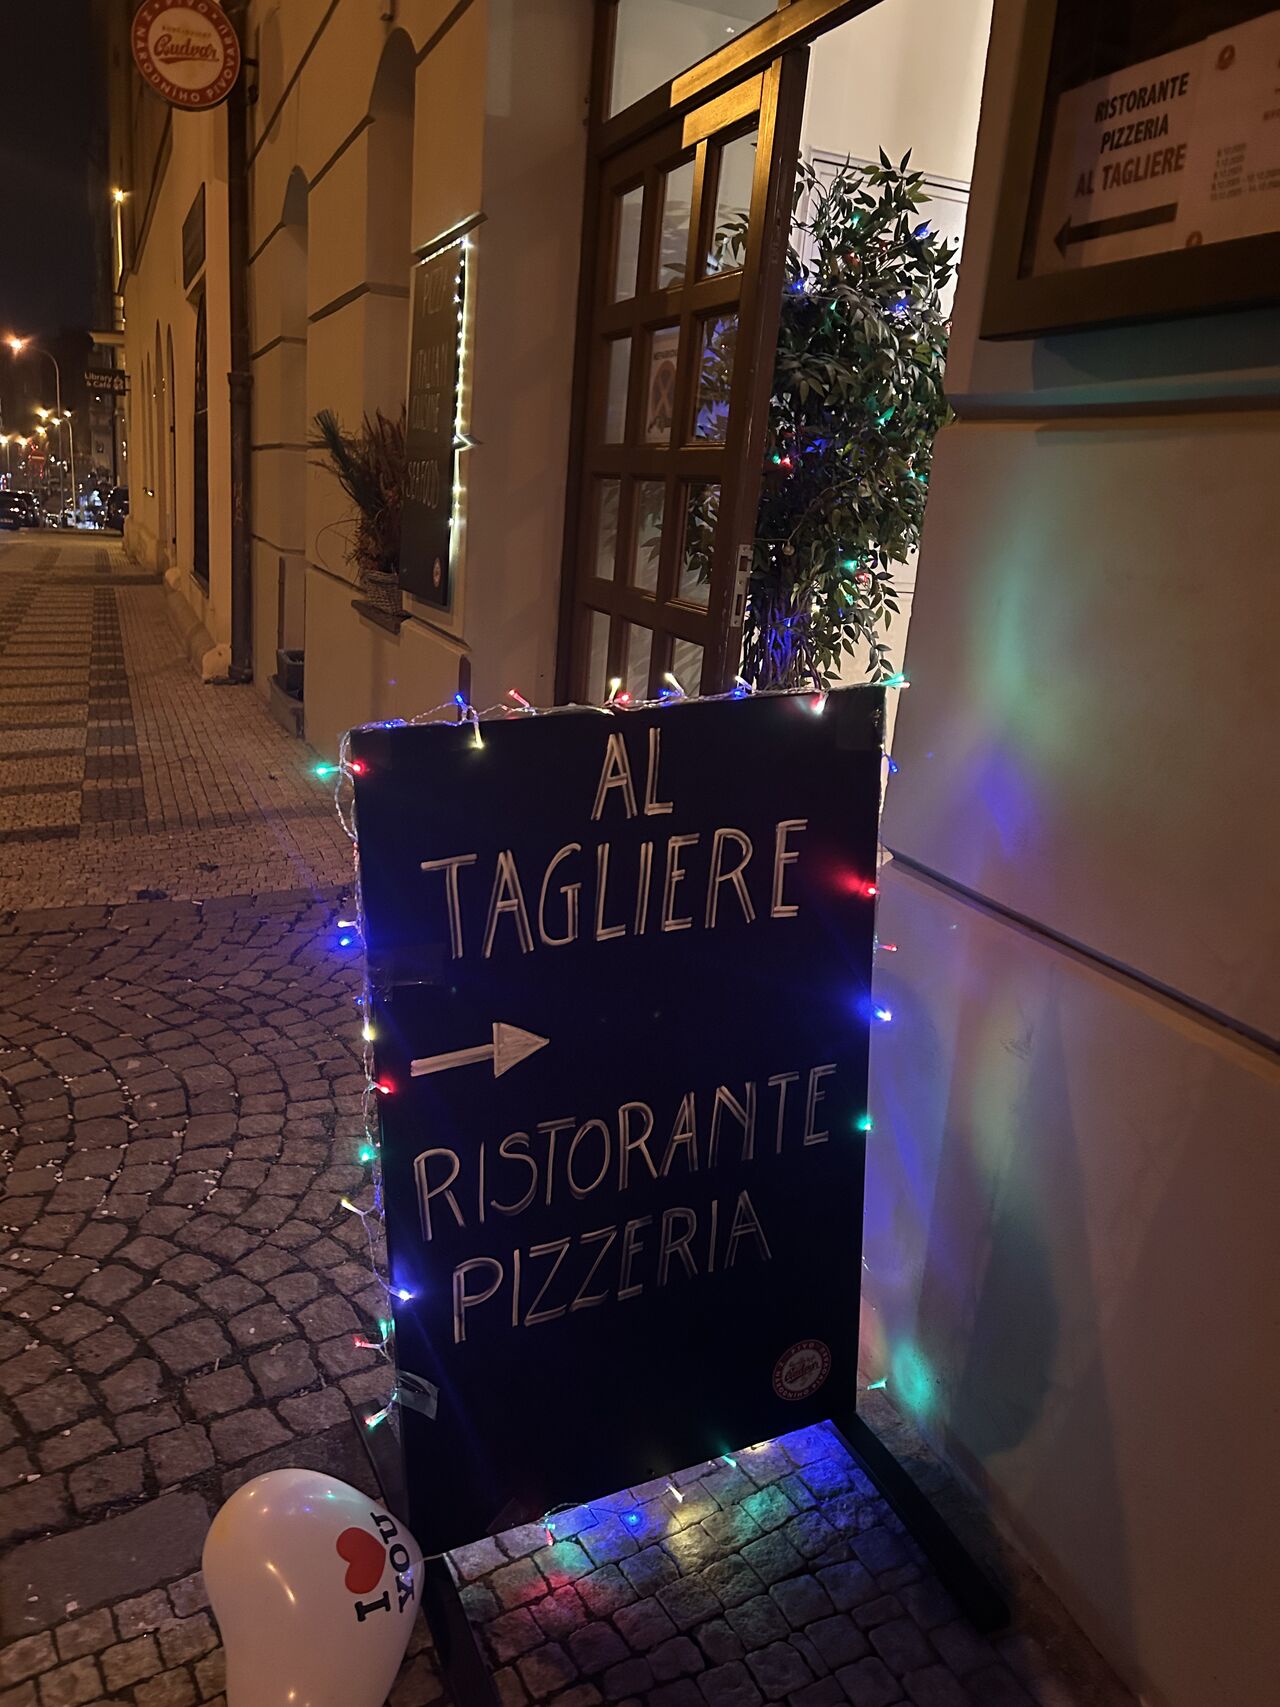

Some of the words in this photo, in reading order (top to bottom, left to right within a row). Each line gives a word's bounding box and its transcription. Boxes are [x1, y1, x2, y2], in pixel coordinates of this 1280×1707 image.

[154, 33, 218, 59] Budvar
[1094, 72, 1190, 123] RISTORANTE
[1100, 113, 1169, 154] PIZZERIA
[1075, 170, 1095, 198] AL
[1101, 142, 1188, 191] TAGLIERE
[589, 727, 675, 822] AL
[420, 818, 809, 961] TAGLIERE
[412, 1063, 839, 1242] RISTORANTE
[452, 1189, 773, 1345] PIZZERIA
[370, 1511, 415, 1614] YOU
[354, 1590, 391, 1622] I
